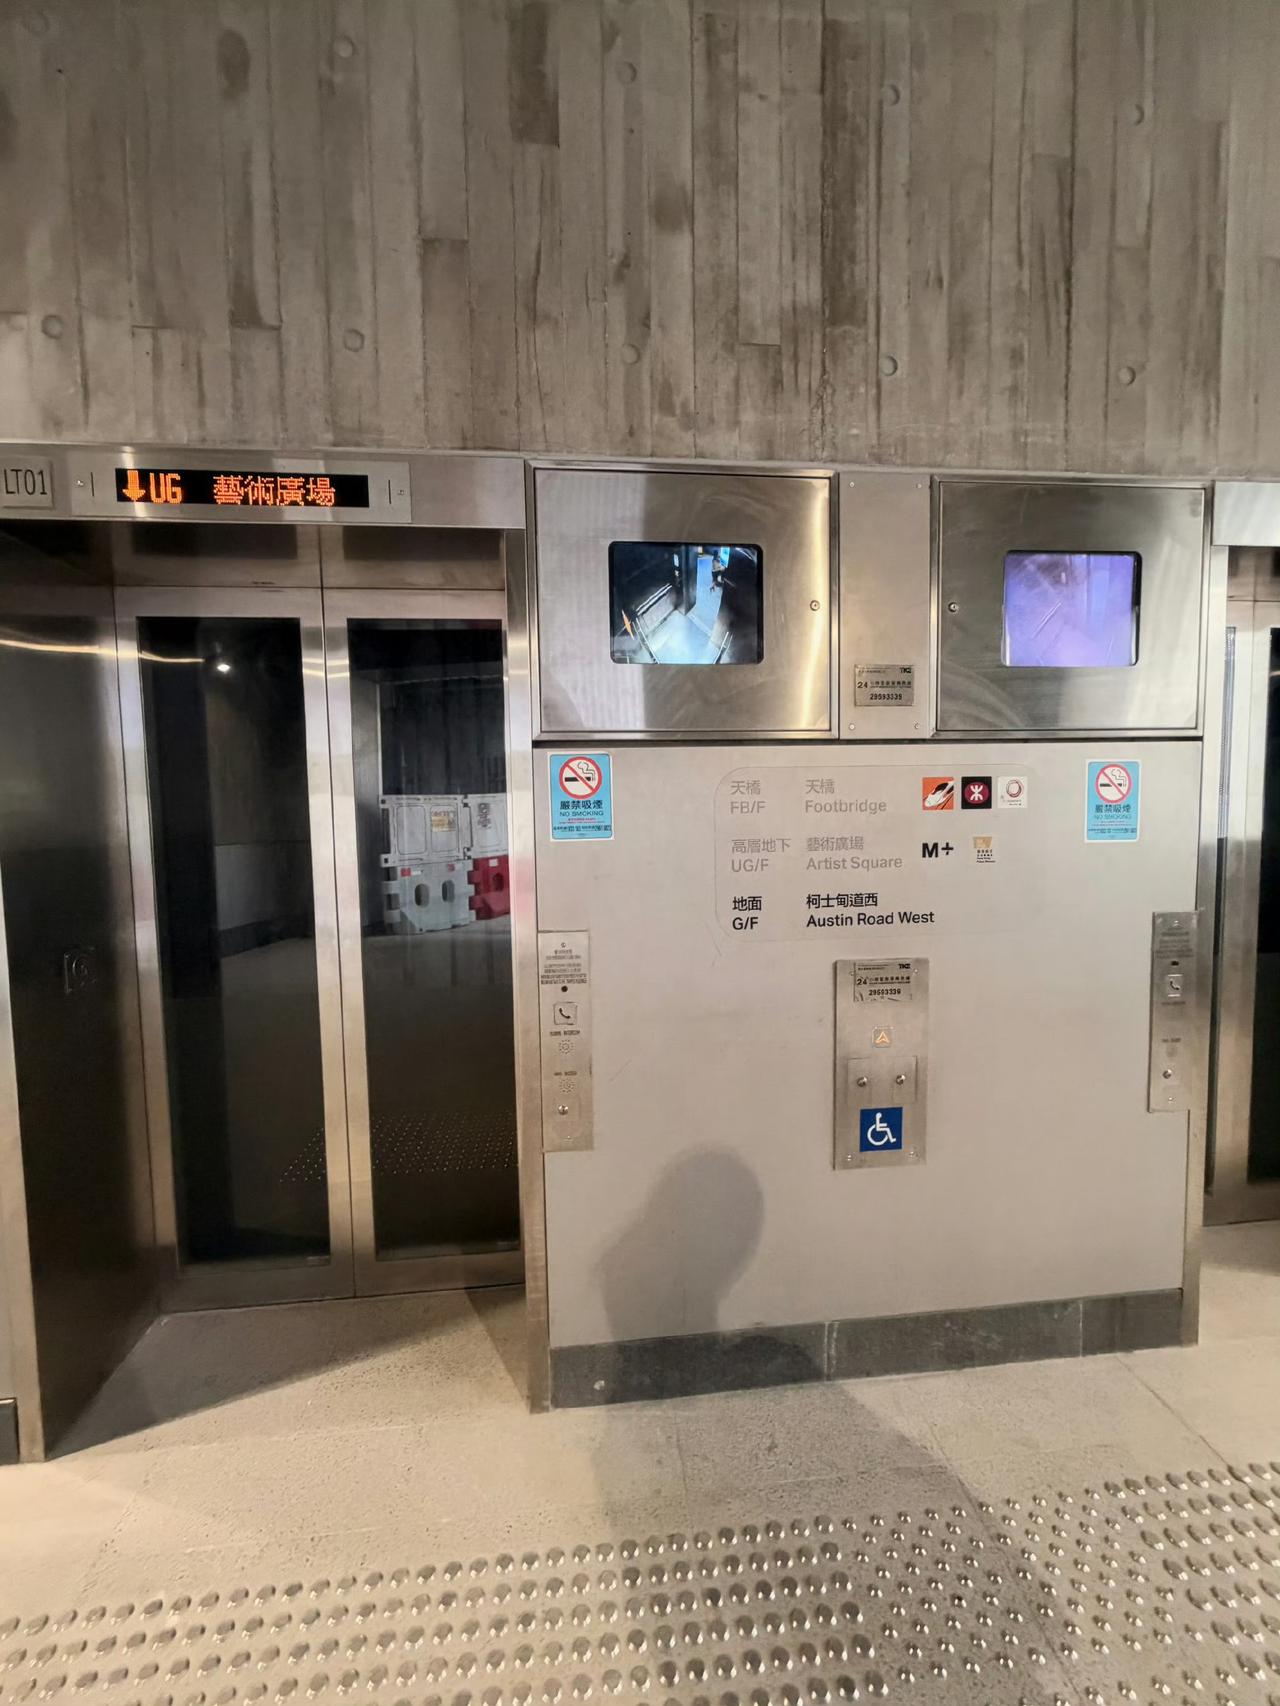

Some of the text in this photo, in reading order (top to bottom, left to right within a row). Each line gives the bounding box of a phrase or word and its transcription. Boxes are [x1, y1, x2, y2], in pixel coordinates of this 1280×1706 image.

[4, 468, 48, 496] LT01
[149, 472, 183, 504] UG
[213, 474, 336, 507] 藝術廣場
[730, 779, 761, 795] 天橋
[805, 778, 836, 794] 天橋
[730, 800, 767, 814] FB/F
[805, 799, 887, 815] Footbridge
[731, 836, 792, 854] 高層地下
[806, 835, 865, 852] 藝術廣場
[922, 842, 954, 858] M+
[731, 858, 769, 873] UG/F
[806, 855, 903, 872] Artist Square
[732, 896, 762, 912] 地面
[806, 892, 878, 909] 柯士甸道西
[732, 916, 759, 931] G/F
[806, 910, 935, 928] Austin Road West
